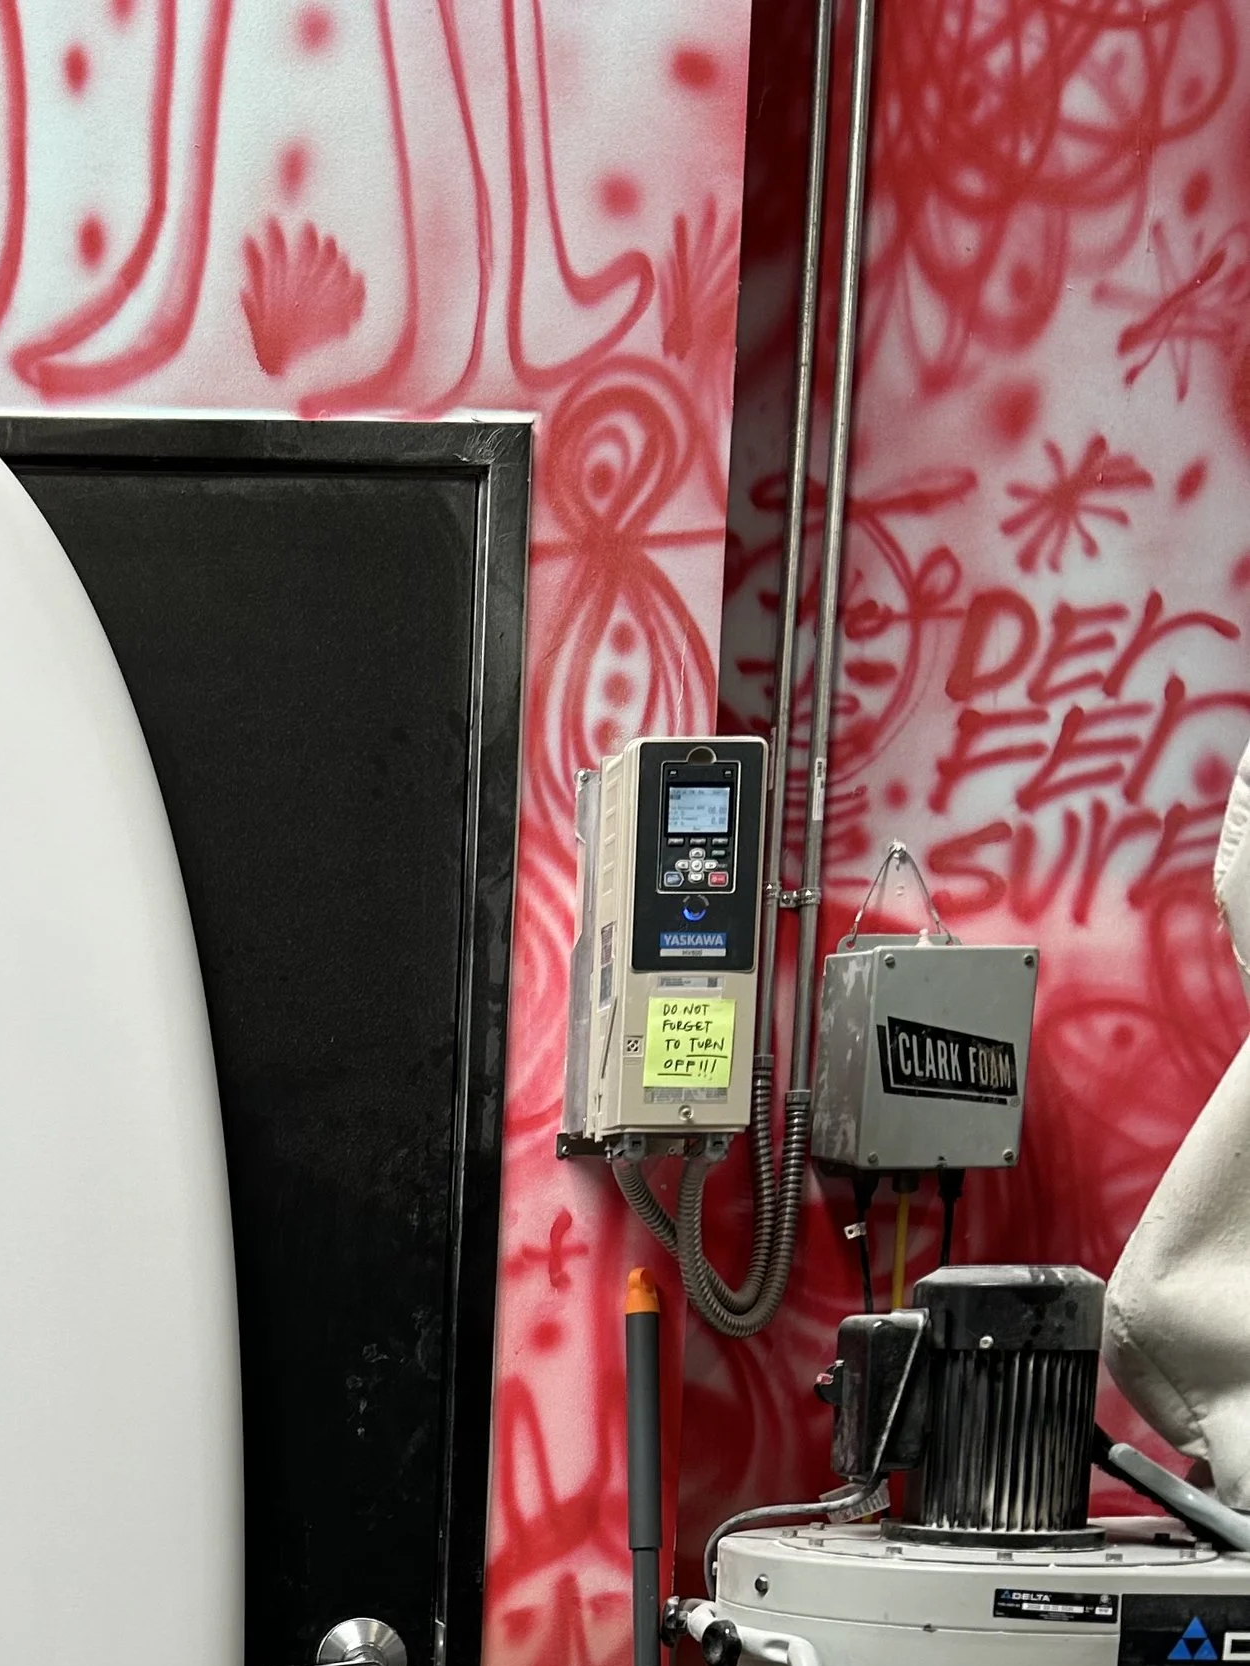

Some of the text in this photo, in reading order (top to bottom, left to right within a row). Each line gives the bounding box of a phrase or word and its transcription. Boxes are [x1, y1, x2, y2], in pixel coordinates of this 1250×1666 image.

[664, 934, 724, 946] YASKAWA
[663, 1003, 710, 1016] DO NOT
[665, 1037, 725, 1052] TO TURN
[899, 1031, 1012, 1088] CLARK FOAM
[1011, 1592, 1051, 1602] DELTA
